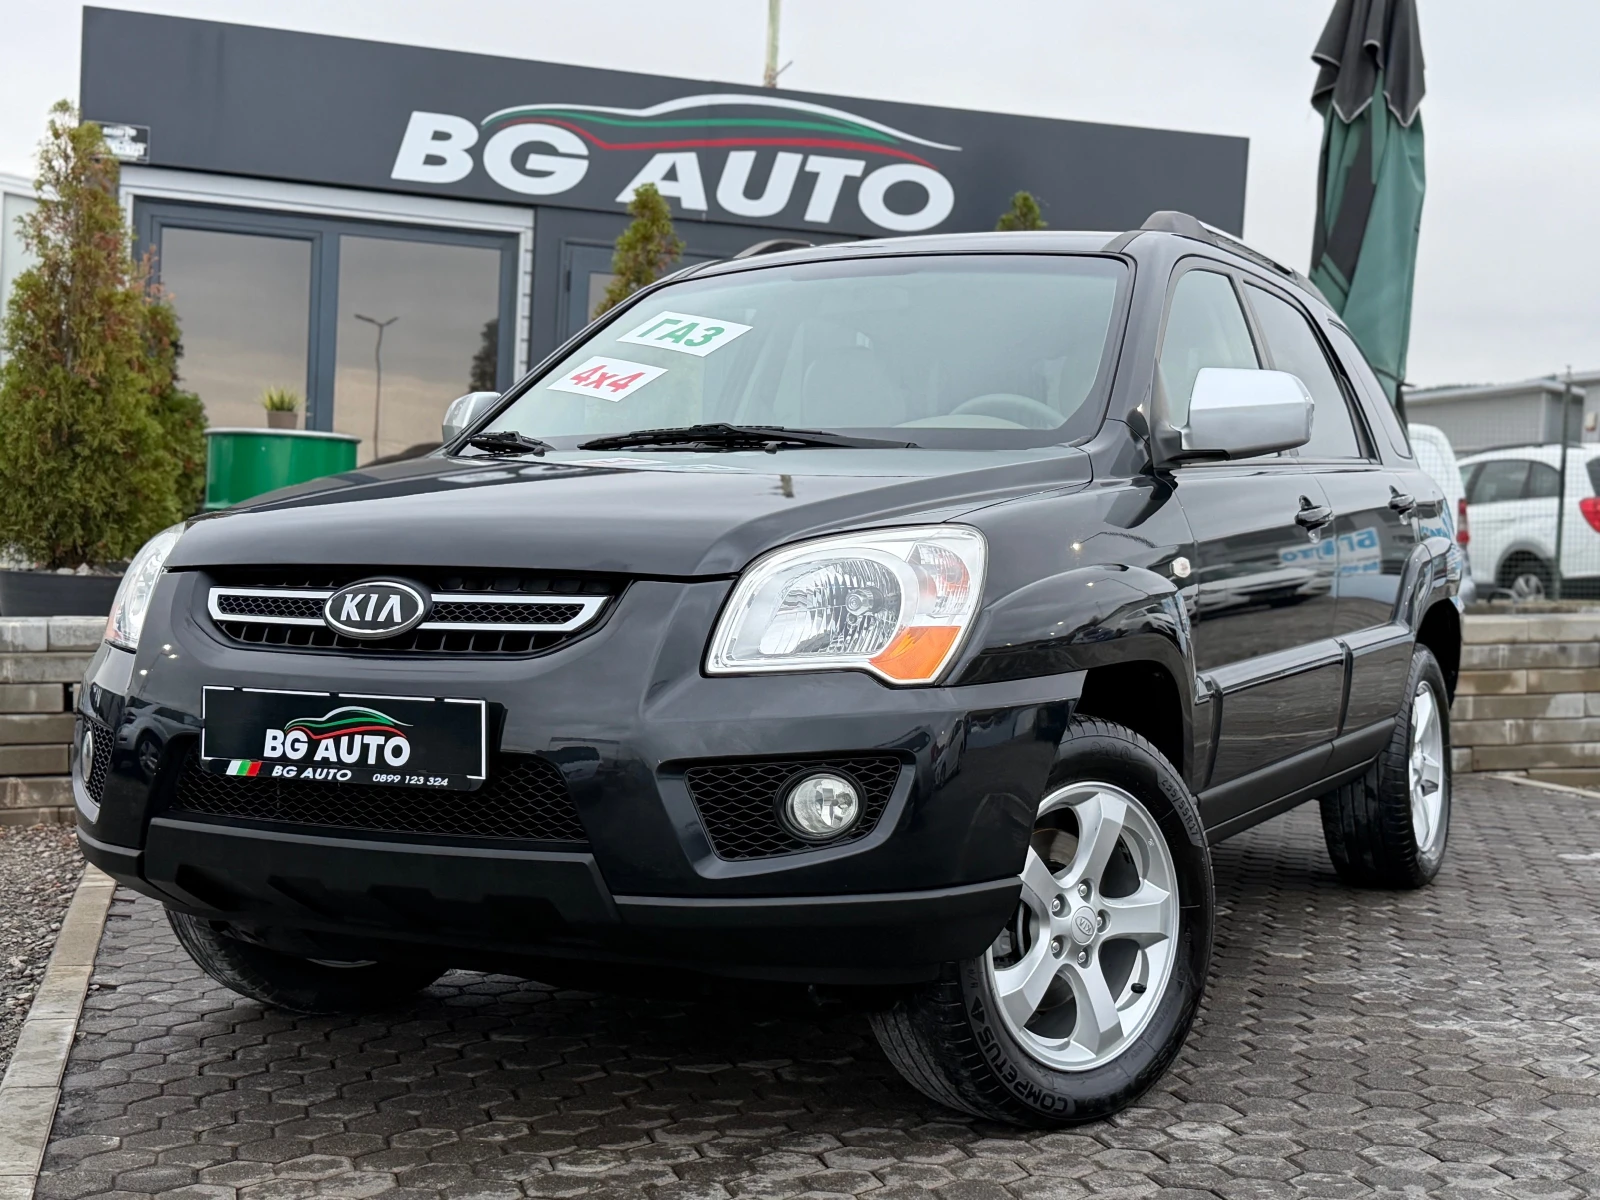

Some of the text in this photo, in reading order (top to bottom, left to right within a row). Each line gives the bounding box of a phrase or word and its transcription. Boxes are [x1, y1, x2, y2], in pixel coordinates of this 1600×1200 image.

[390, 110, 955, 231] BG AUTO
[636, 318, 725, 347] ГАЗ
[570, 364, 646, 393] 4x4
[340, 593, 402, 623] KIA
[263, 728, 411, 767] BG AUTO
[271, 765, 449, 787] BG AUTO 0899 123 324
[977, 1024, 1069, 1114] COMPETUS
